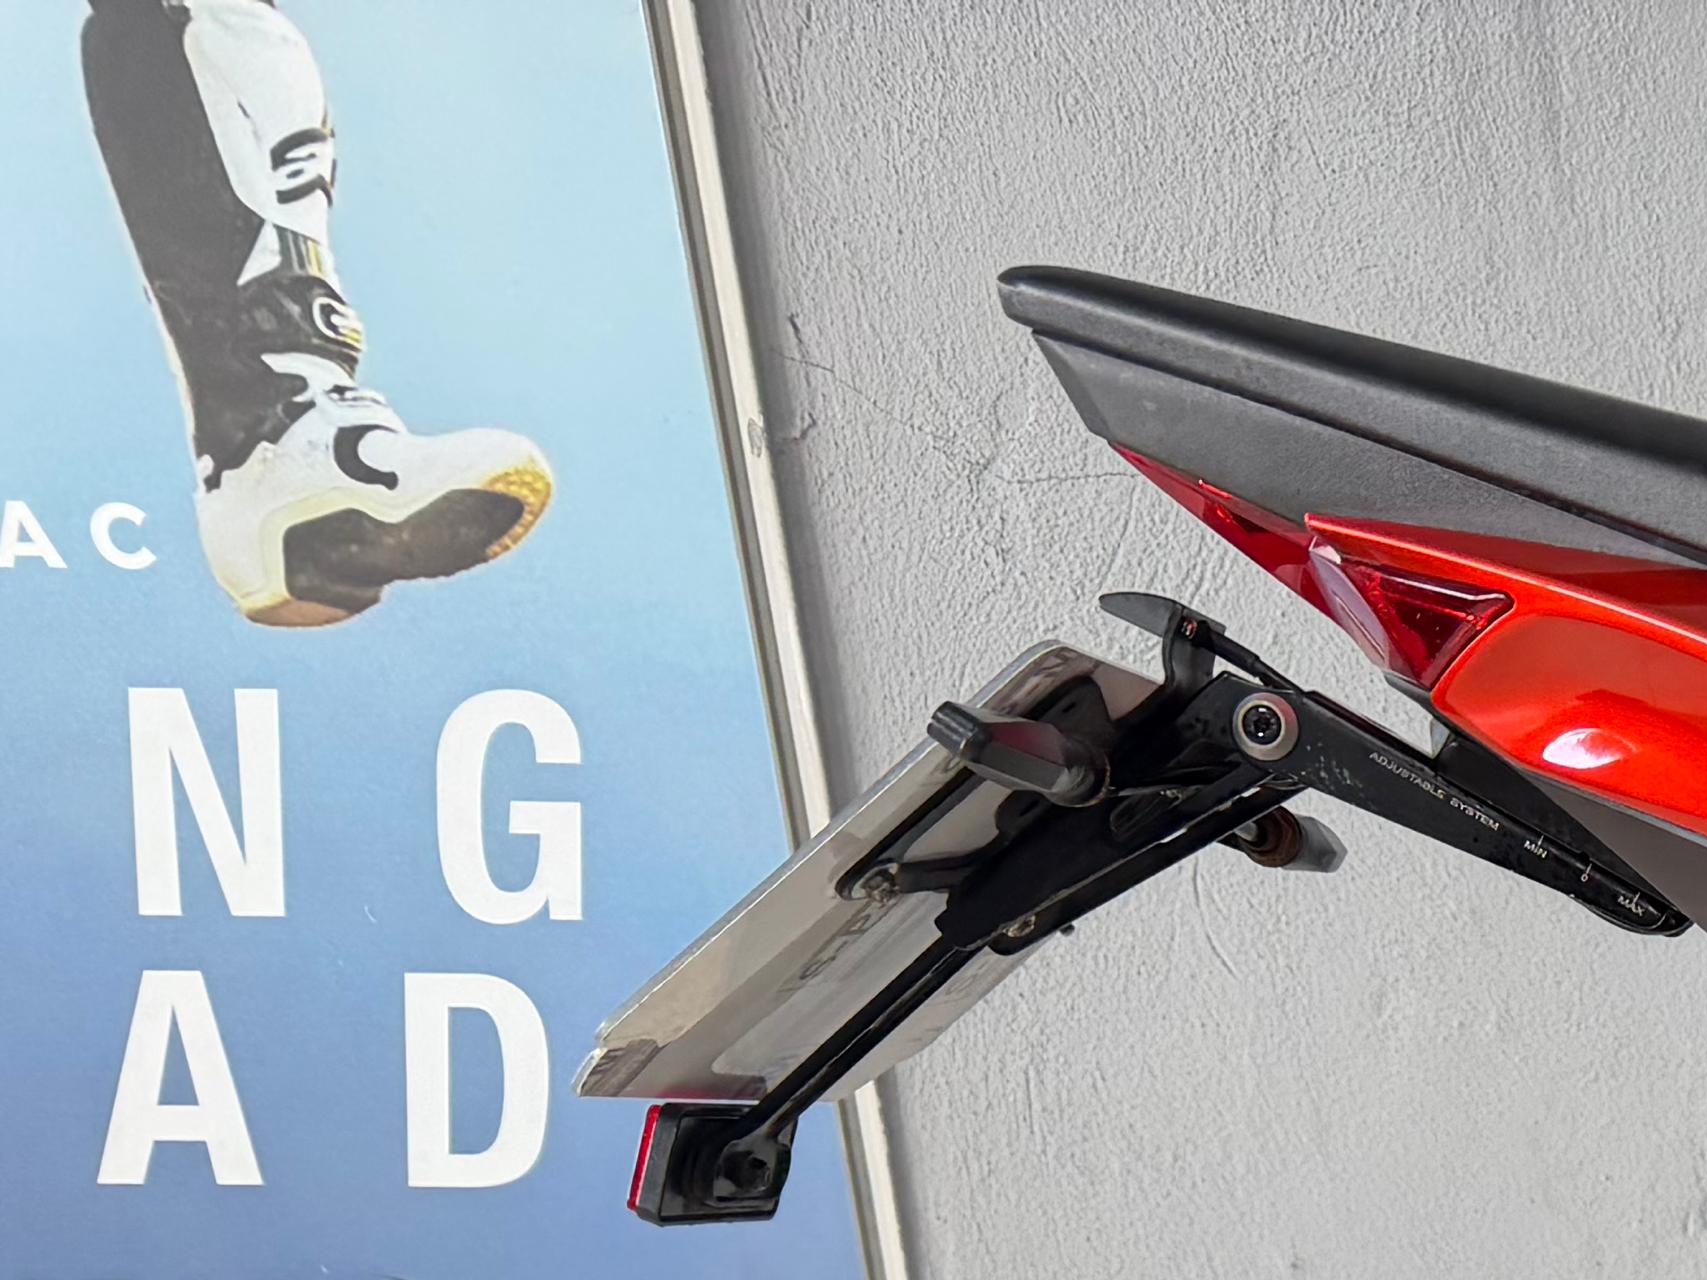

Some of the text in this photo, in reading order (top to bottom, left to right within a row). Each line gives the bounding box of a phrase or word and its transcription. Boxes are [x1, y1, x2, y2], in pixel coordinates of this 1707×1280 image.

[0, 499, 158, 571] AC
[1369, 751, 1500, 831] ADJUSTABLE SYSTEM
[1523, 838, 1548, 858] MIN
[1617, 894, 1645, 917] MAX
